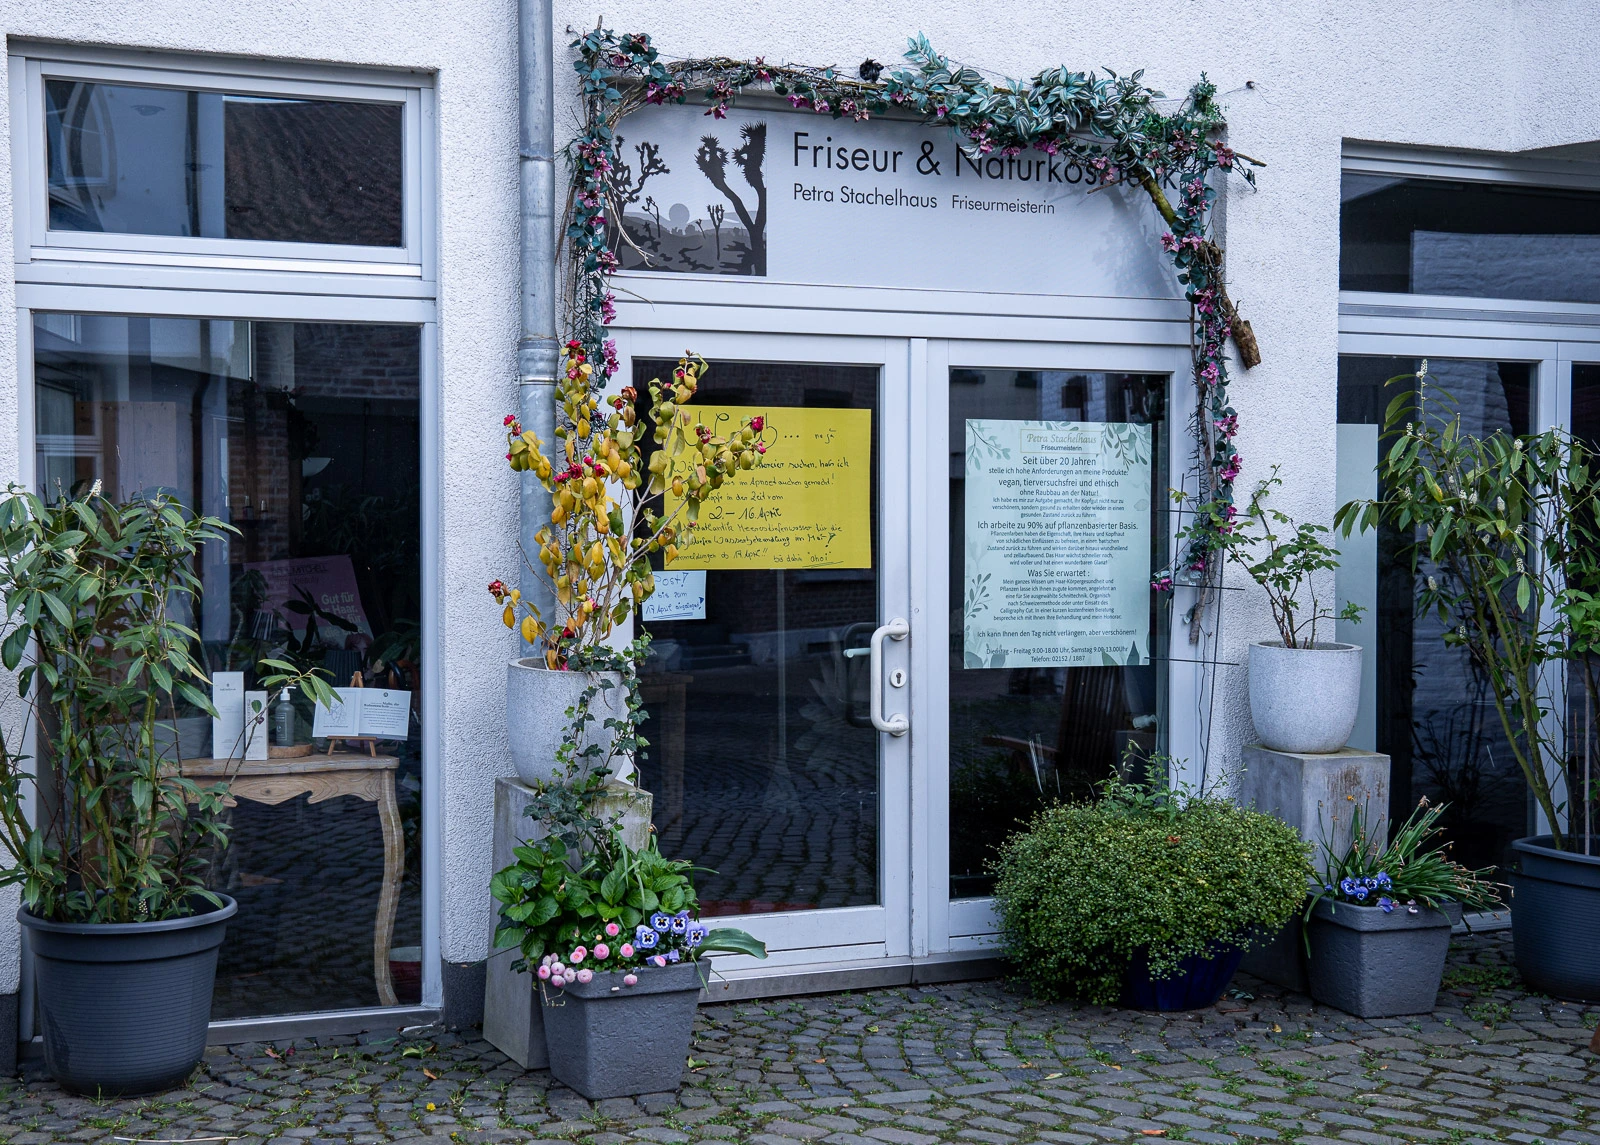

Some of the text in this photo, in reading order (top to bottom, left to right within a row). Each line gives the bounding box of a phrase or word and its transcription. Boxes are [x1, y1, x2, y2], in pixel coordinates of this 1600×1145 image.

[794, 132, 904, 173] Friseur
[916, 140, 941, 176] &
[794, 182, 1055, 214] Petra Stachelhaus Friseurmeisterin
[1023, 456, 1096, 466] Seit über 20 Jahren
[1031, 468, 1073, 476] Anforderungen
[999, 478, 1118, 488] vegan, tierversuchsfrei und ethisch
[751, 491, 766, 501] Zeit
[1057, 521, 1117, 531] pflanzenbasierter
[321, 592, 354, 605] Gut für
[332, 604, 358, 615] Haar.
[348, 614, 361, 624] für
[325, 627, 340, 637] die
[1057, 630, 1086, 638] verlängern,
